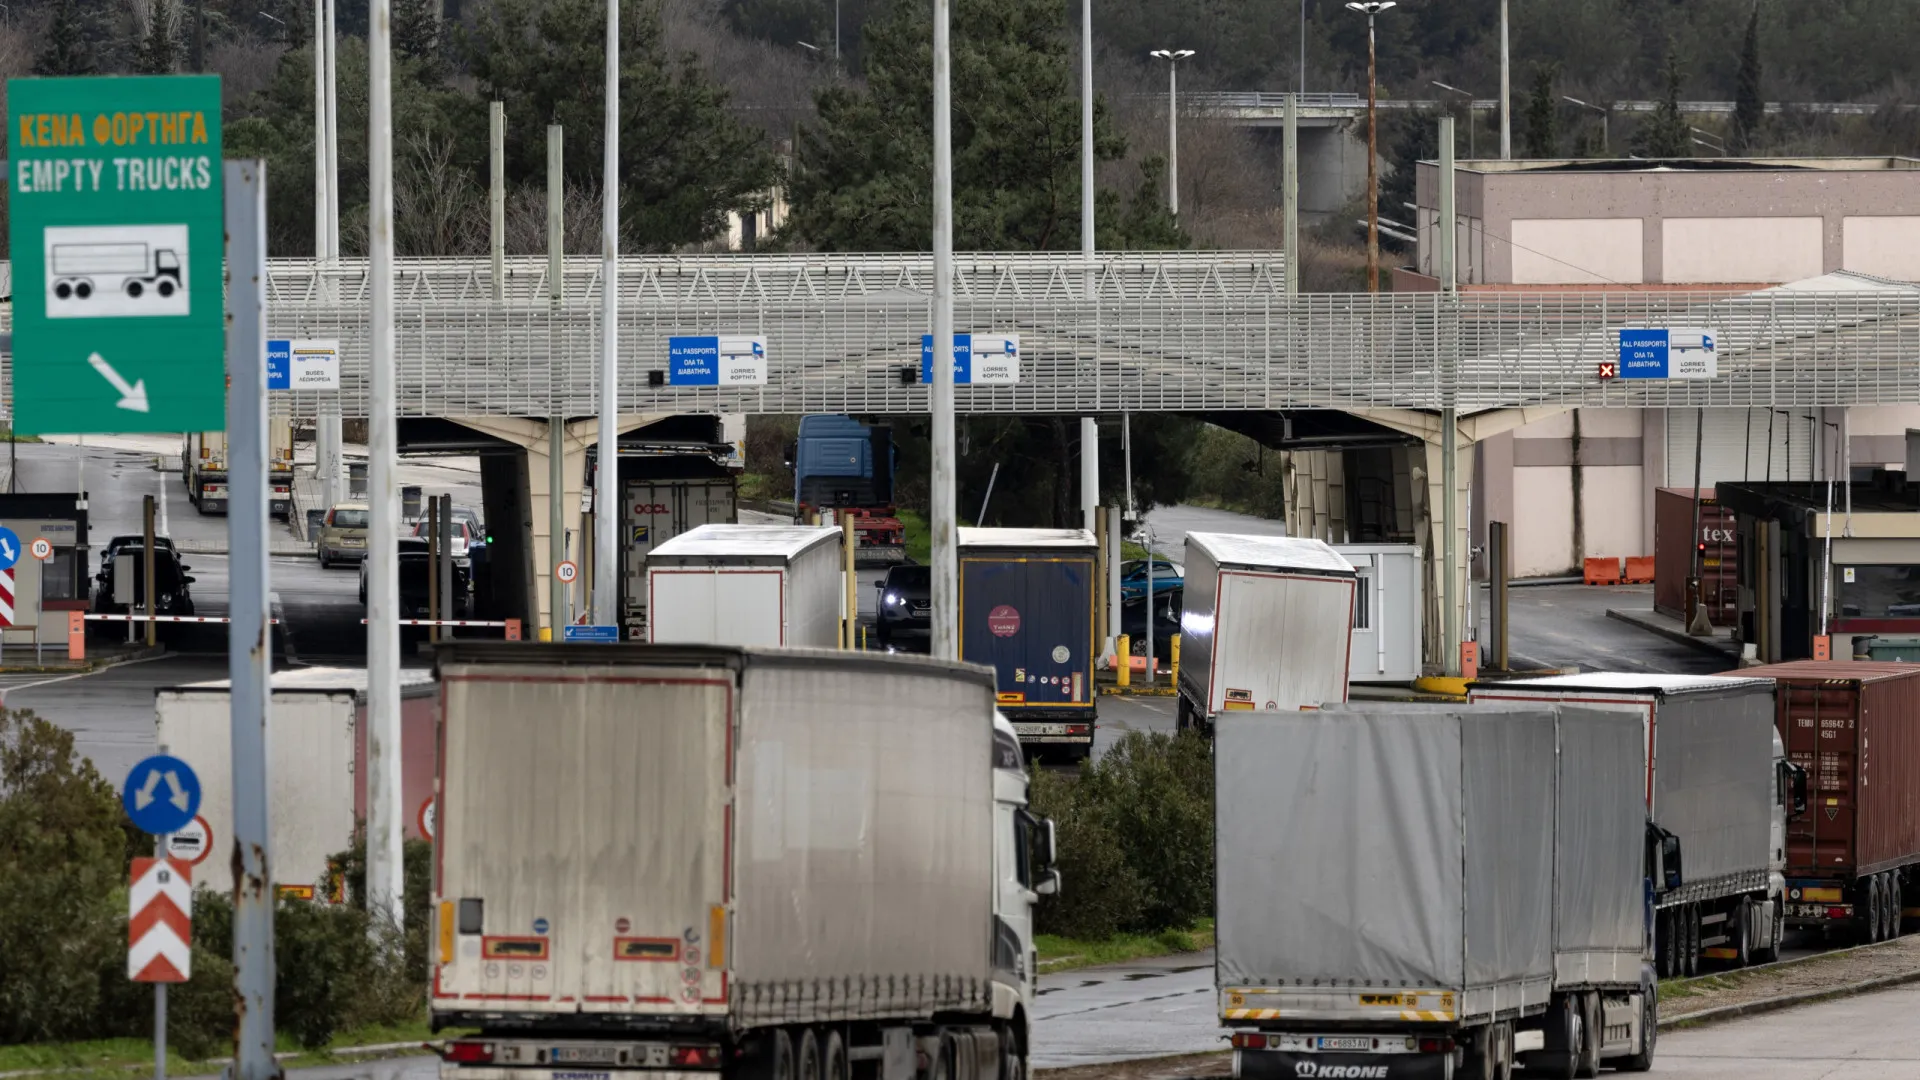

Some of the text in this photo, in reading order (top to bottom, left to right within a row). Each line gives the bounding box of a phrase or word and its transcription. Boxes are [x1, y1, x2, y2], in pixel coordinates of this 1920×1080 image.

[19, 111, 208, 147] ΚΕΝΑ ΦΟΡΤΗΓΑ
[17, 155, 211, 193] EMPTY TRUCKS
[1633, 340, 1667, 348] PASSPORTS
[683, 347, 717, 355] PASSPORTS
[1703, 525, 1734, 542] tex
[36, 543, 47, 553] 10
[562, 567, 573, 577] 10
[1798, 719, 1814, 728] TEMU
[1820, 719, 1845, 729] 659642
[1820, 730, 1837, 739] 45G1
[1318, 1065, 1389, 1078] KRONE
